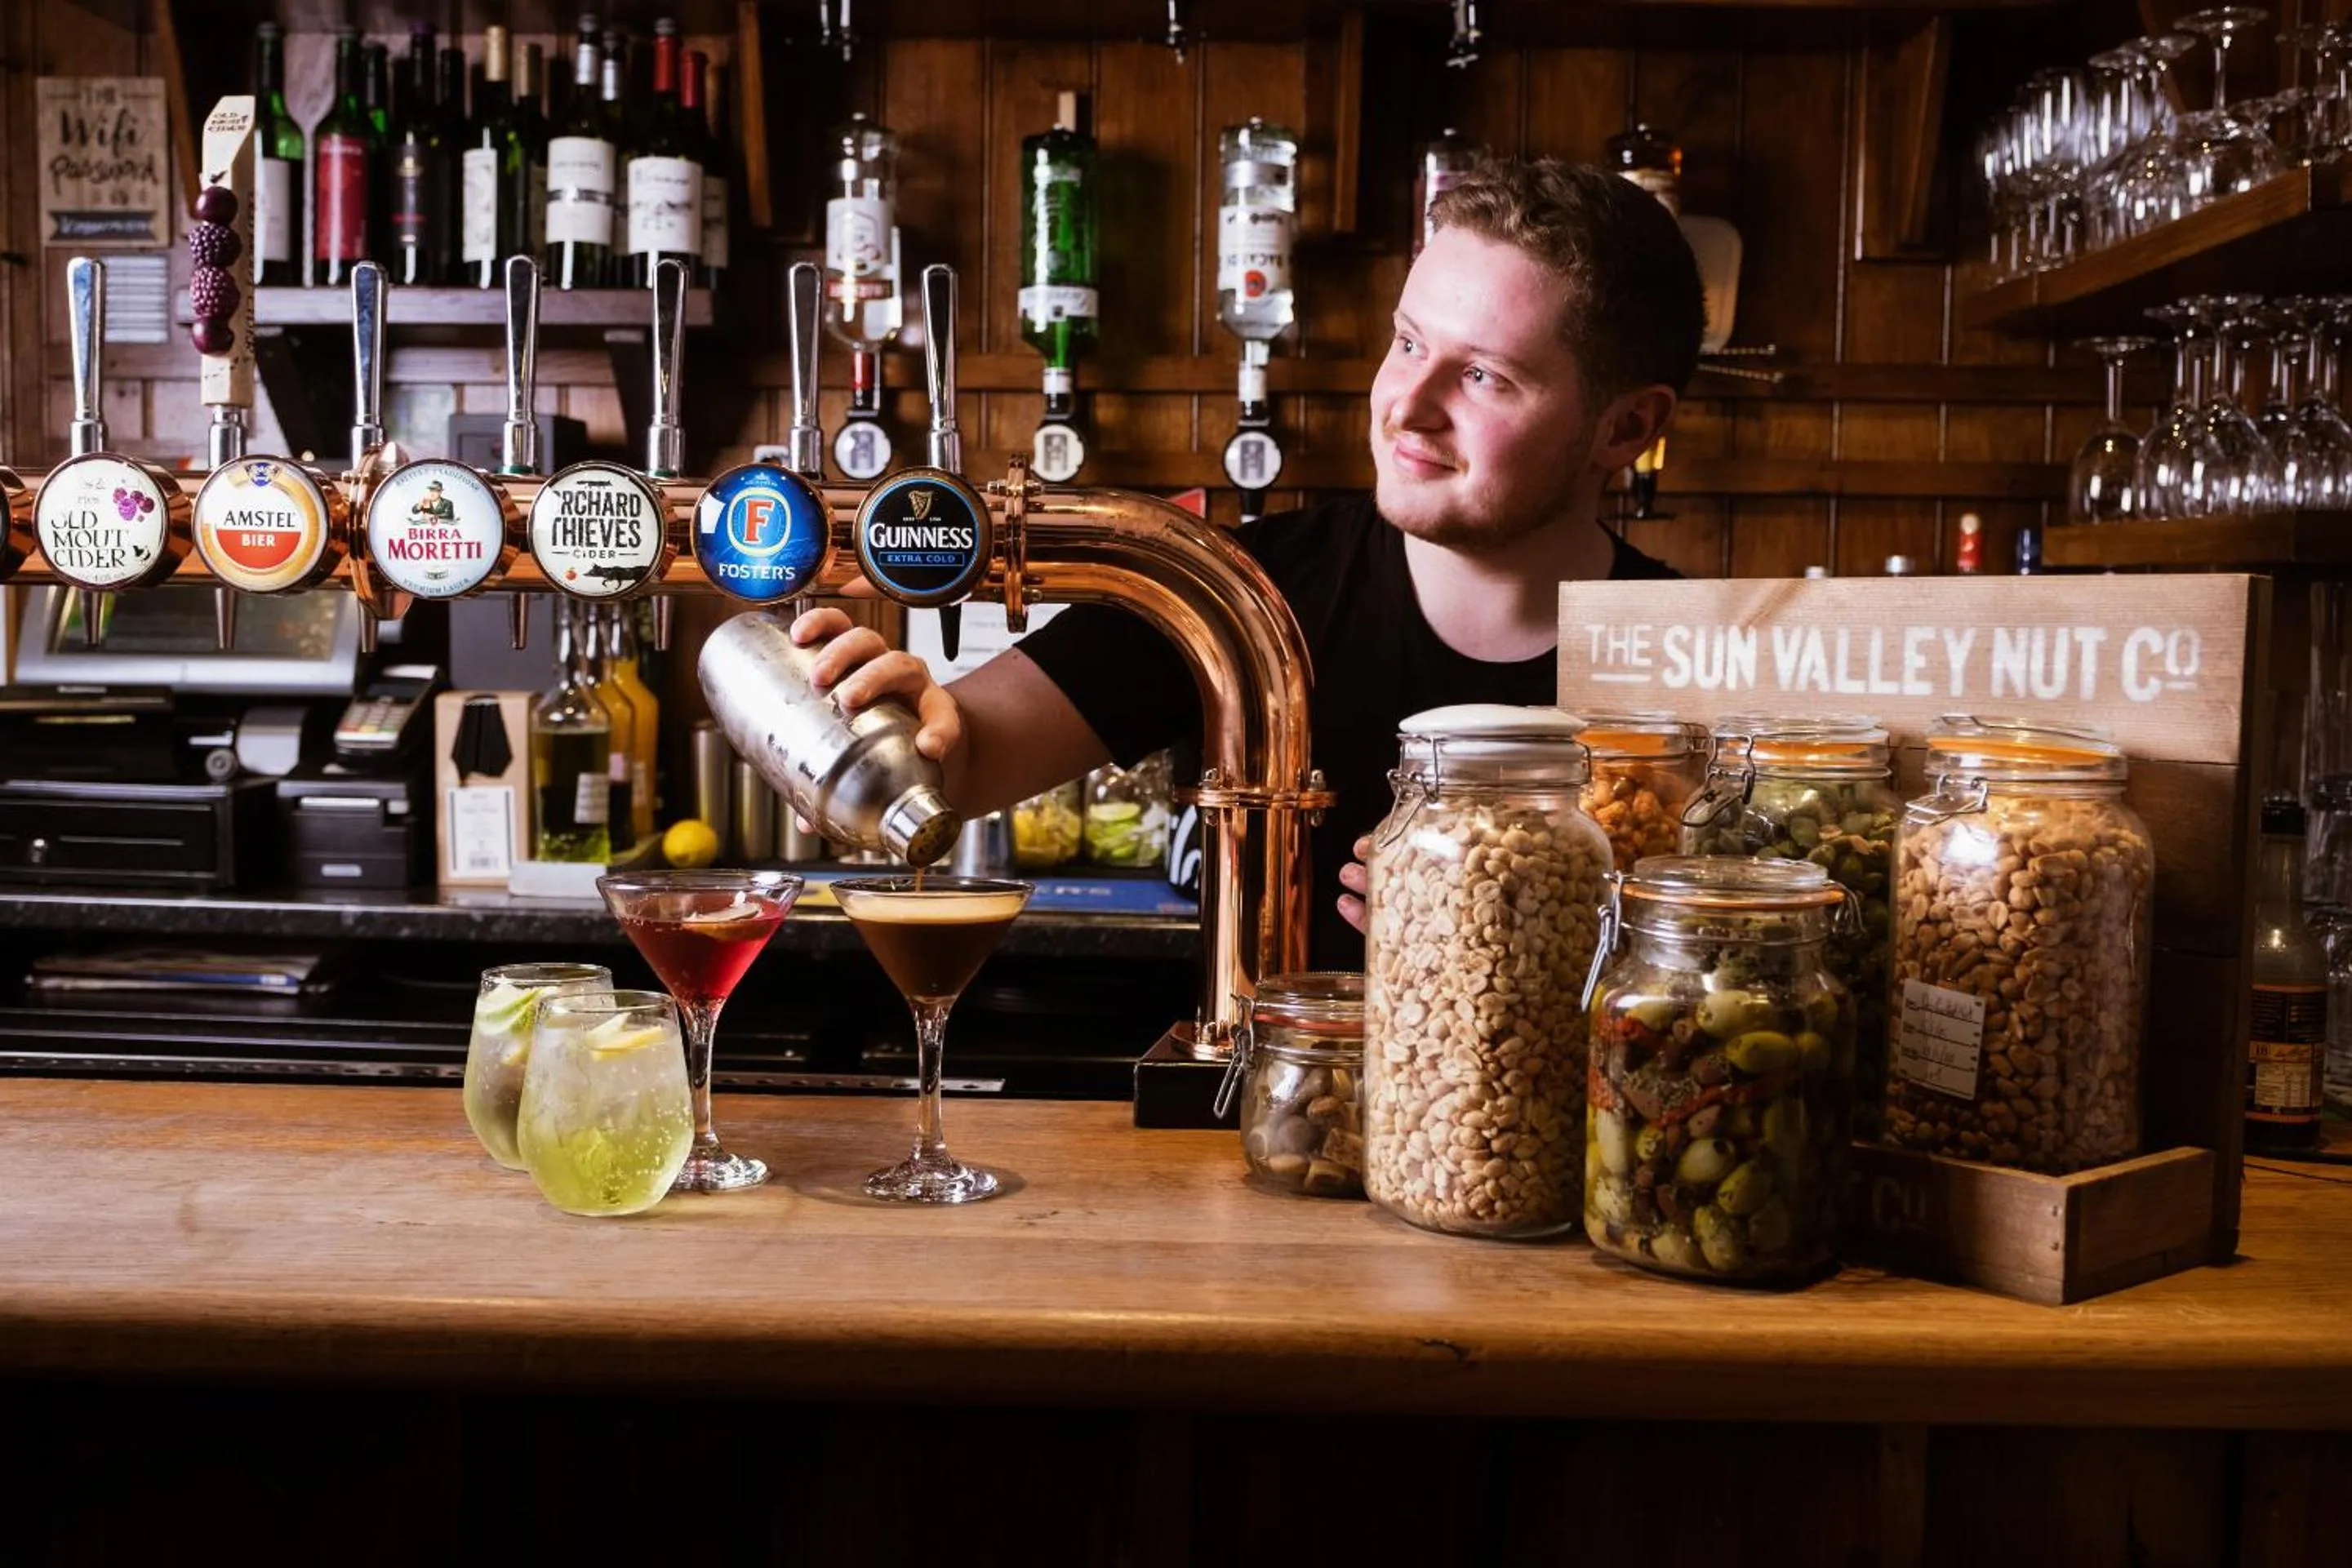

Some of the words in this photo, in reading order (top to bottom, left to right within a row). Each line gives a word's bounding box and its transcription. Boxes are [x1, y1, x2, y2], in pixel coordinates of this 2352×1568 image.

[553, 490, 642, 517] RCHARD
[224, 510, 296, 527] AMSTEL
[743, 498, 776, 544] F
[53, 529, 127, 548] MOUT
[241, 534, 275, 547] BIER
[407, 528, 462, 540] BIRRA
[551, 517, 642, 548] THIEVES
[869, 522, 973, 549] GUINNESS
[54, 549, 126, 568] CIDER
[388, 539, 482, 560] MORETTI
[887, 553, 922, 563] EXTRA
[926, 554, 955, 564] COLD
[718, 562, 796, 580] FOSTER'S
[1585, 624, 1653, 666] THE
[1661, 624, 1758, 691] SUN
[1772, 624, 1977, 699] VALLEY
[1990, 626, 2108, 700] NUT
